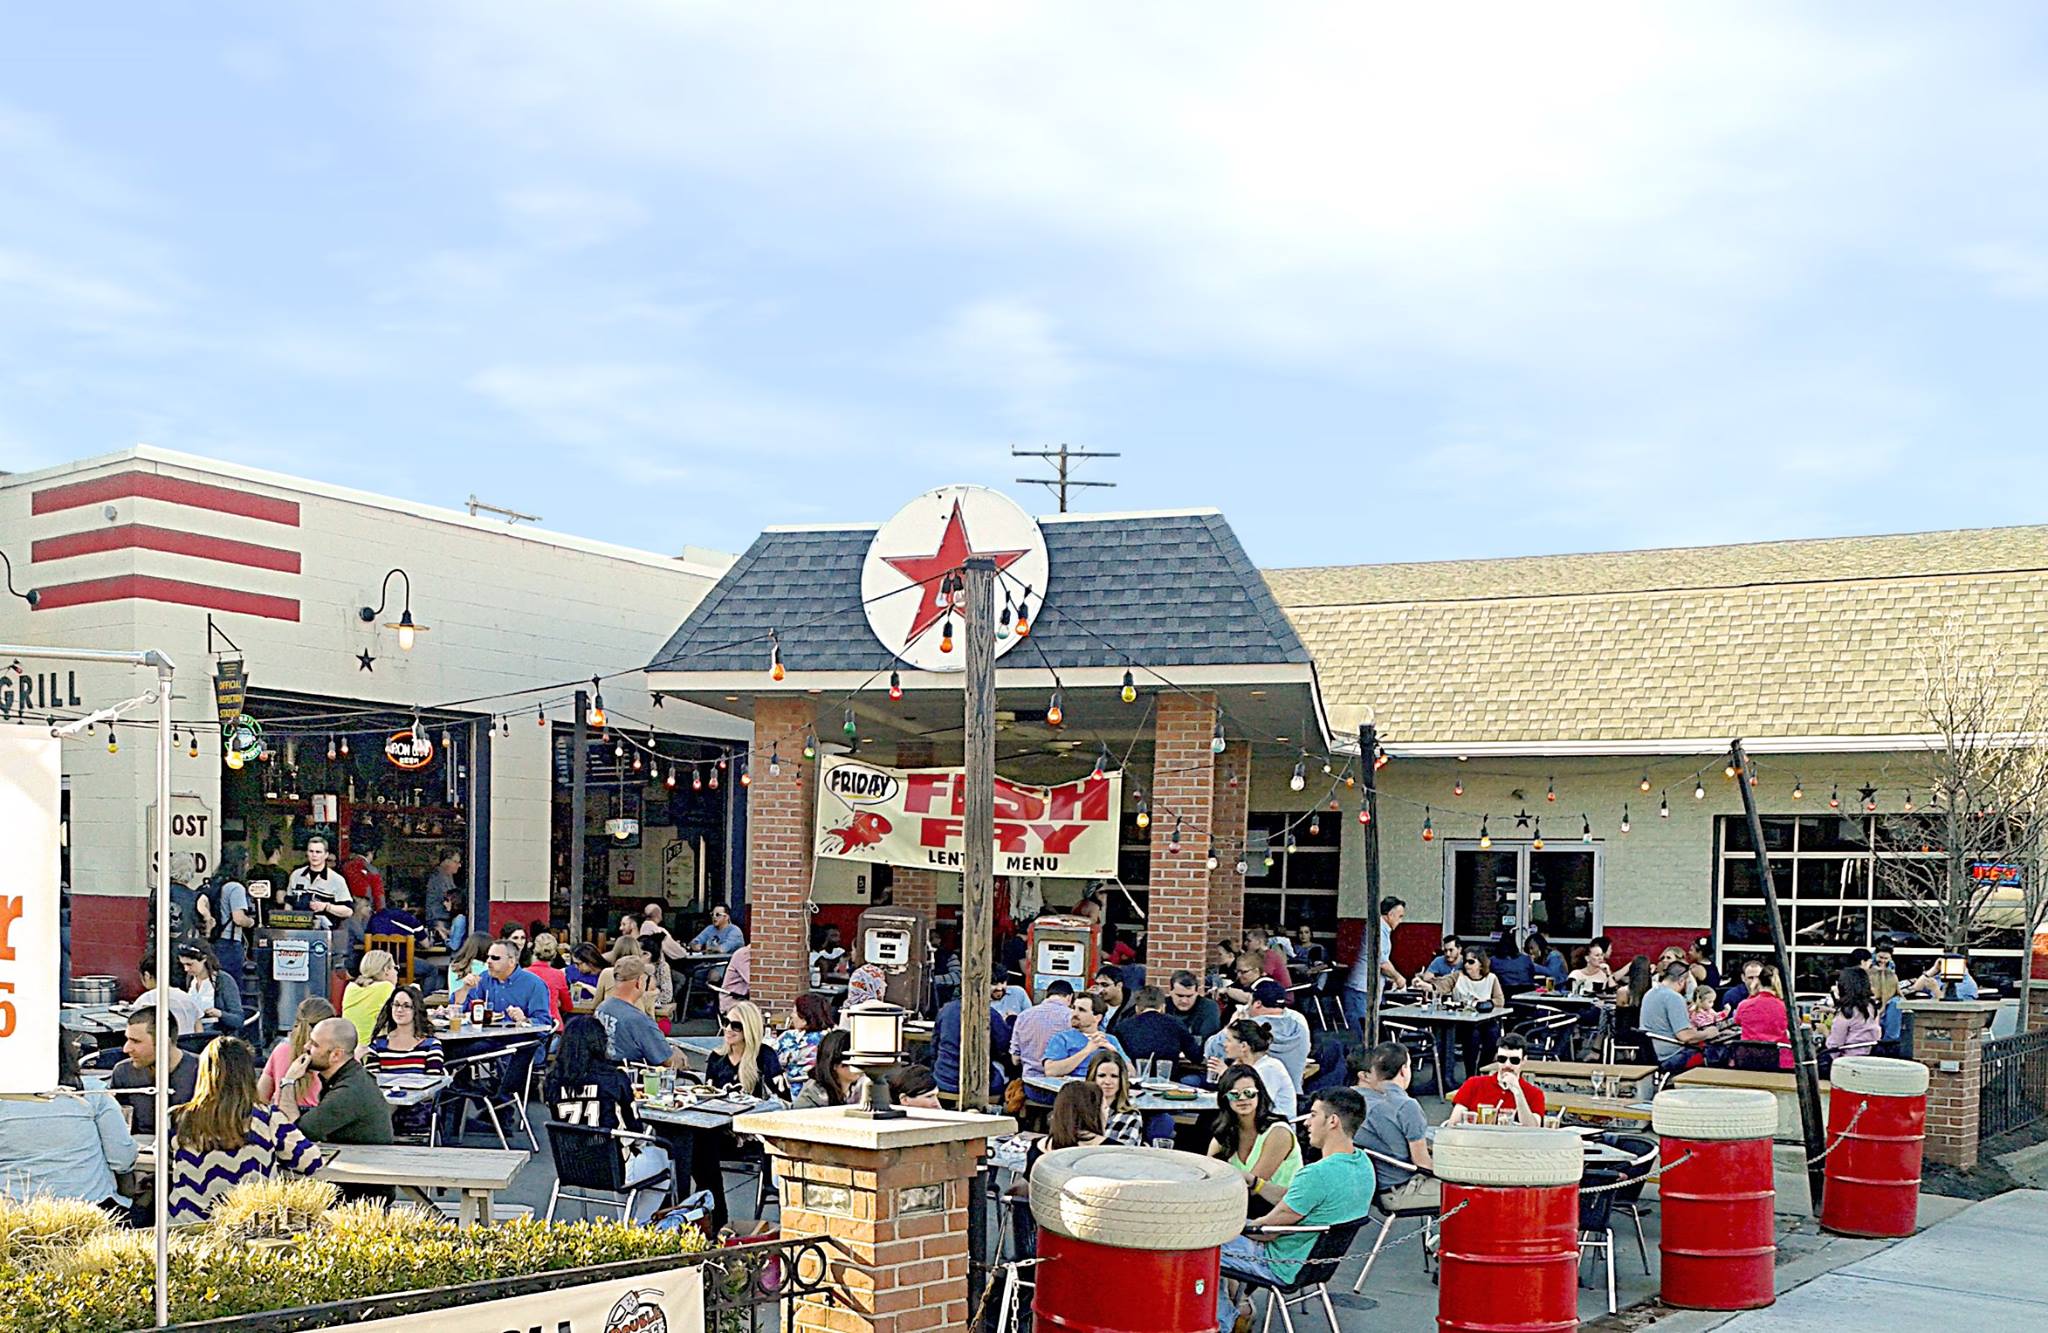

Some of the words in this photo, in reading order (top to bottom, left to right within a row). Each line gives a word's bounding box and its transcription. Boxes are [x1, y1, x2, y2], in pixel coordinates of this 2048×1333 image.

[0, 670, 81, 712] GRILL
[386, 741, 410, 756] RON
[830, 769, 891, 798] FRIDAY
[903, 773, 1110, 821] FISH
[169, 814, 209, 837] OST
[919, 817, 1090, 854] FRY
[1006, 856, 1059, 871] MENU
[556, 1100, 600, 1127] 71
